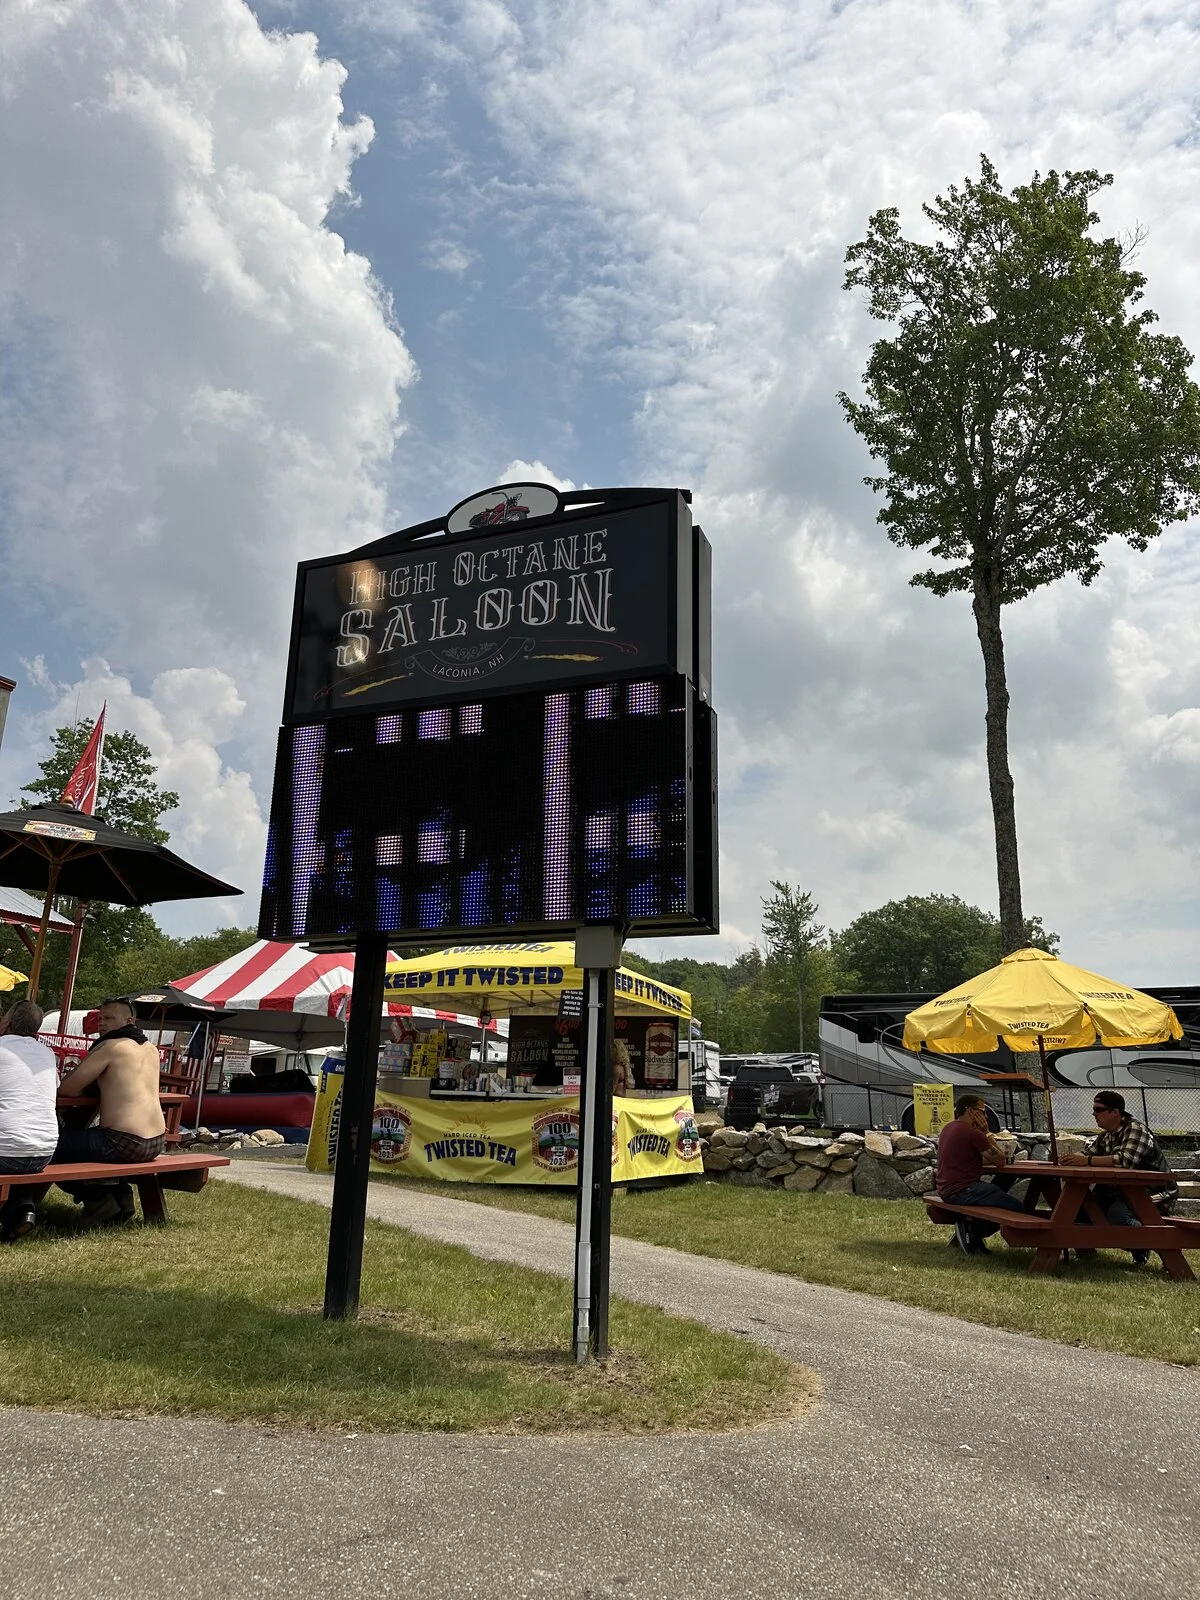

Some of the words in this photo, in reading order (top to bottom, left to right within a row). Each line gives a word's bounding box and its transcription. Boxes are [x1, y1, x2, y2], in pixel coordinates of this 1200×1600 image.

[349, 561, 438, 605] HIGH
[452, 528, 608, 586] OCTANE
[334, 568, 617, 667] SALOON
[432, 663, 485, 678] LACONIA,
[488, 653, 505, 668] NH
[437, 969, 460, 987] IT
[463, 967, 564, 986] TWISTED
[615, 973, 633, 993] EEP
[634, 979, 643, 997] IT
[1110, 991, 1135, 1001] TEA
[1007, 1021, 1036, 1030] TWISTED
[1036, 1021, 1050, 1029] TEA
[62, 1035, 87, 1050] SPONSOR
[510, 1048, 549, 1062] SALOON
[379, 1117, 400, 1129] 100
[547, 1123, 571, 1135] 100
[424, 1139, 486, 1163] TWISTED
[488, 1142, 519, 1167] TEA
[627, 1133, 659, 1161] TWISTED
[657, 1135, 671, 1159] TEA
[549, 1158, 568, 1166] 2023
